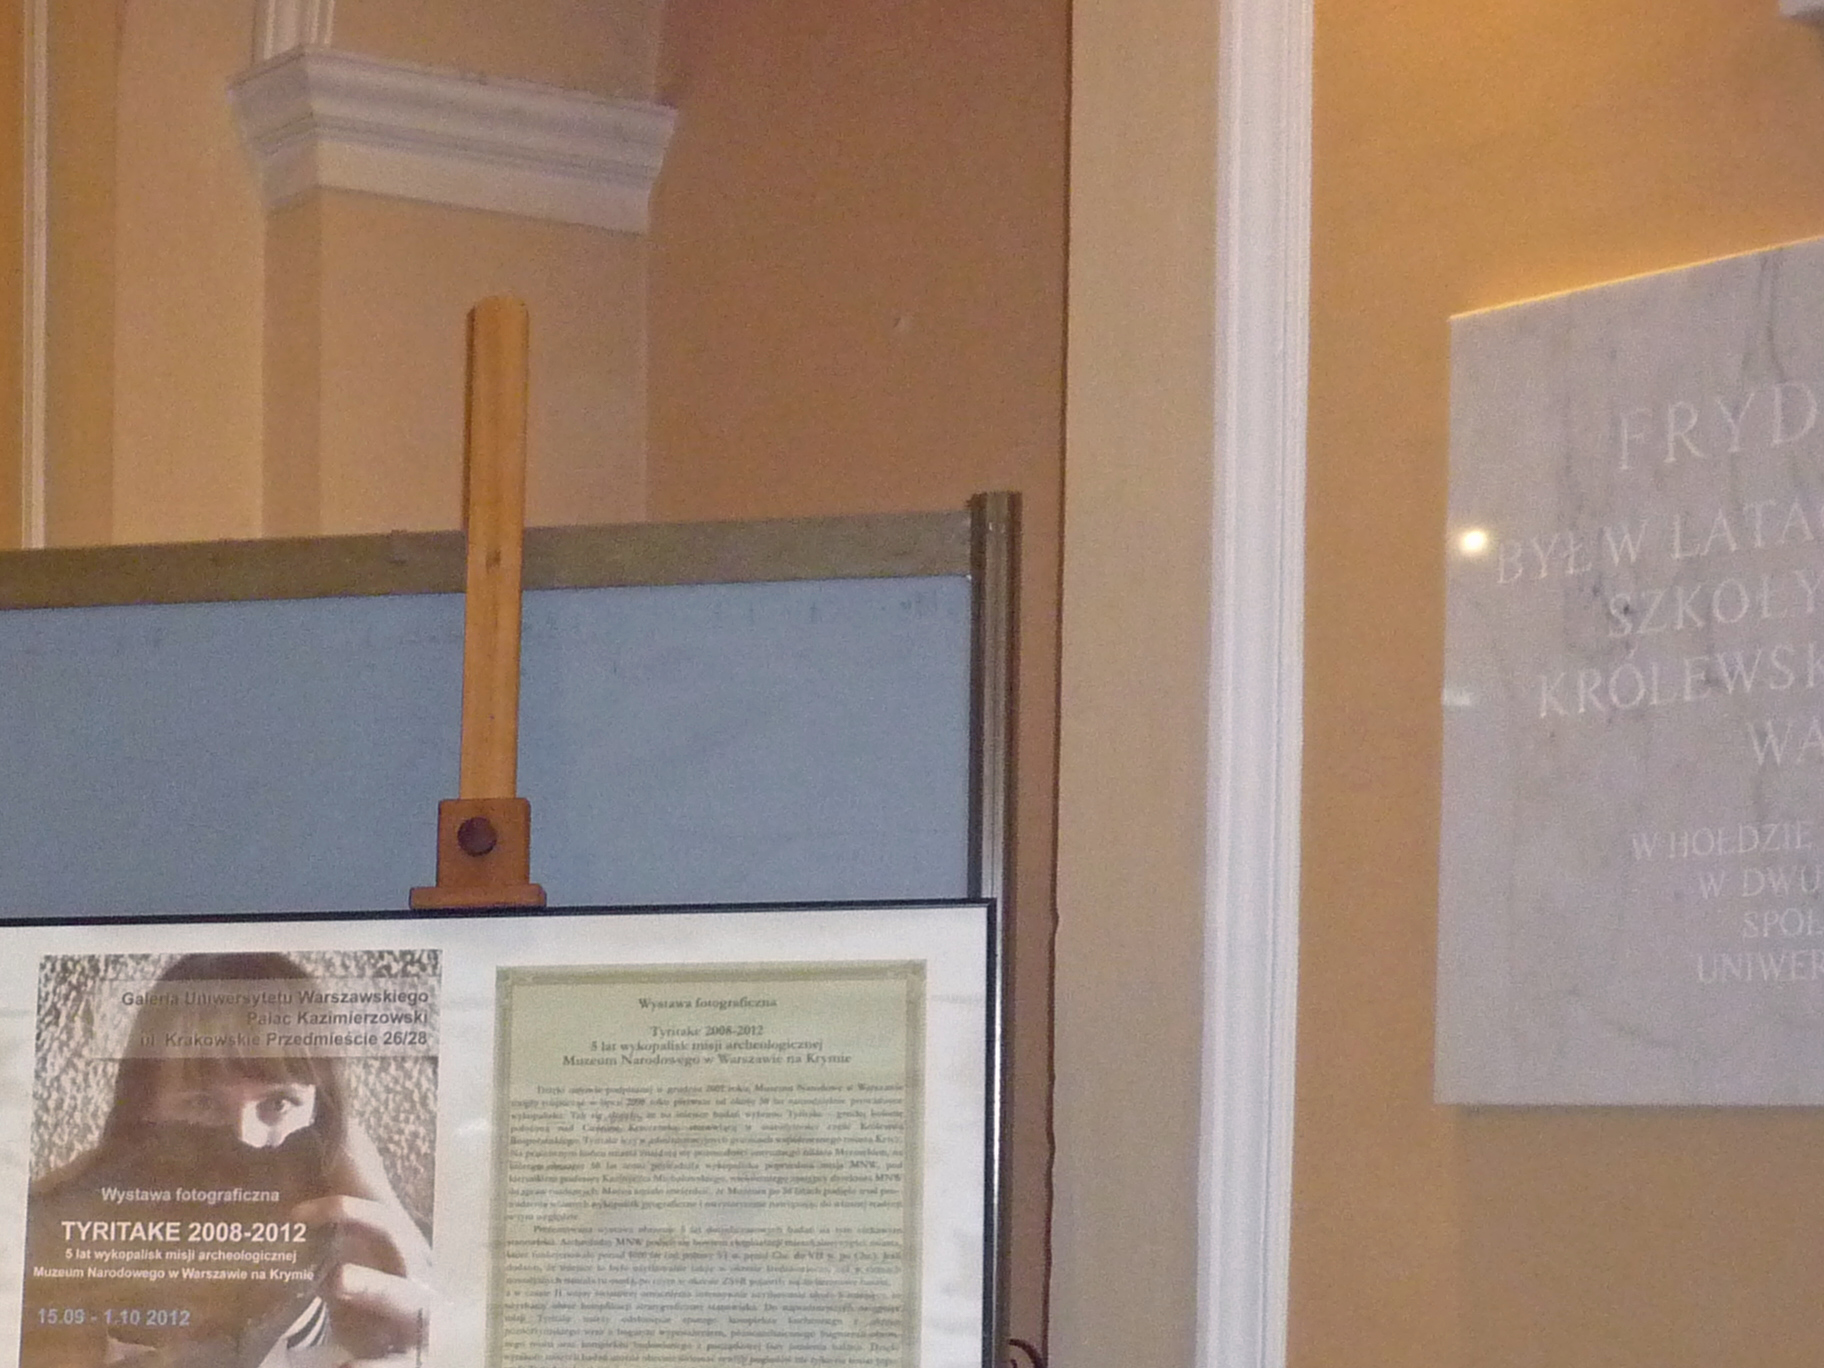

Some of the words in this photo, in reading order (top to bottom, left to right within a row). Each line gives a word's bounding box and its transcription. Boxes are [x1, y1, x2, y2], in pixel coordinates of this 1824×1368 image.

[1603, 519, 1649, 567] W
[1670, 499, 1824, 560] LATA
[120, 993, 178, 1007] Galeria
[184, 992, 292, 1008] Uniwersytetu
[297, 990, 429, 1009] Warszawskiego
[695, 997, 778, 1010] fotograficzna
[296, 1010, 428, 1025] Kazimierzowski
[165, 1033, 260, 1047] Krakowskie
[265, 1030, 377, 1047] Przedmieście
[382, 1030, 427, 1046] 26/28
[563, 1056, 617, 1066] Muzeum
[621, 1055, 700, 1068] Narodowego
[101, 1187, 171, 1204] Wystawa
[175, 1187, 279, 1205] fotograficzna
[61, 1220, 181, 1242] TYRITAKE
[187, 1222, 306, 1243] 2008-2012
[65, 1248, 72, 1260] 5
[75, 1248, 91, 1260] lat
[94, 1248, 162, 1264] wykopalisk
[165, 1250, 194, 1264] misji
[198, 1249, 297, 1265] archeologicznej
[33, 1266, 84, 1279] Muzeum
[87, 1266, 165, 1282] Narodowego
[168, 1270, 179, 1280] w
[182, 1267, 248, 1281] Warszawie
[251, 1270, 266, 1280] na
[270, 1268, 314, 1283] Krymie
[38, 1308, 85, 1325] 15.09
[145, 1309, 191, 1326] 2012
